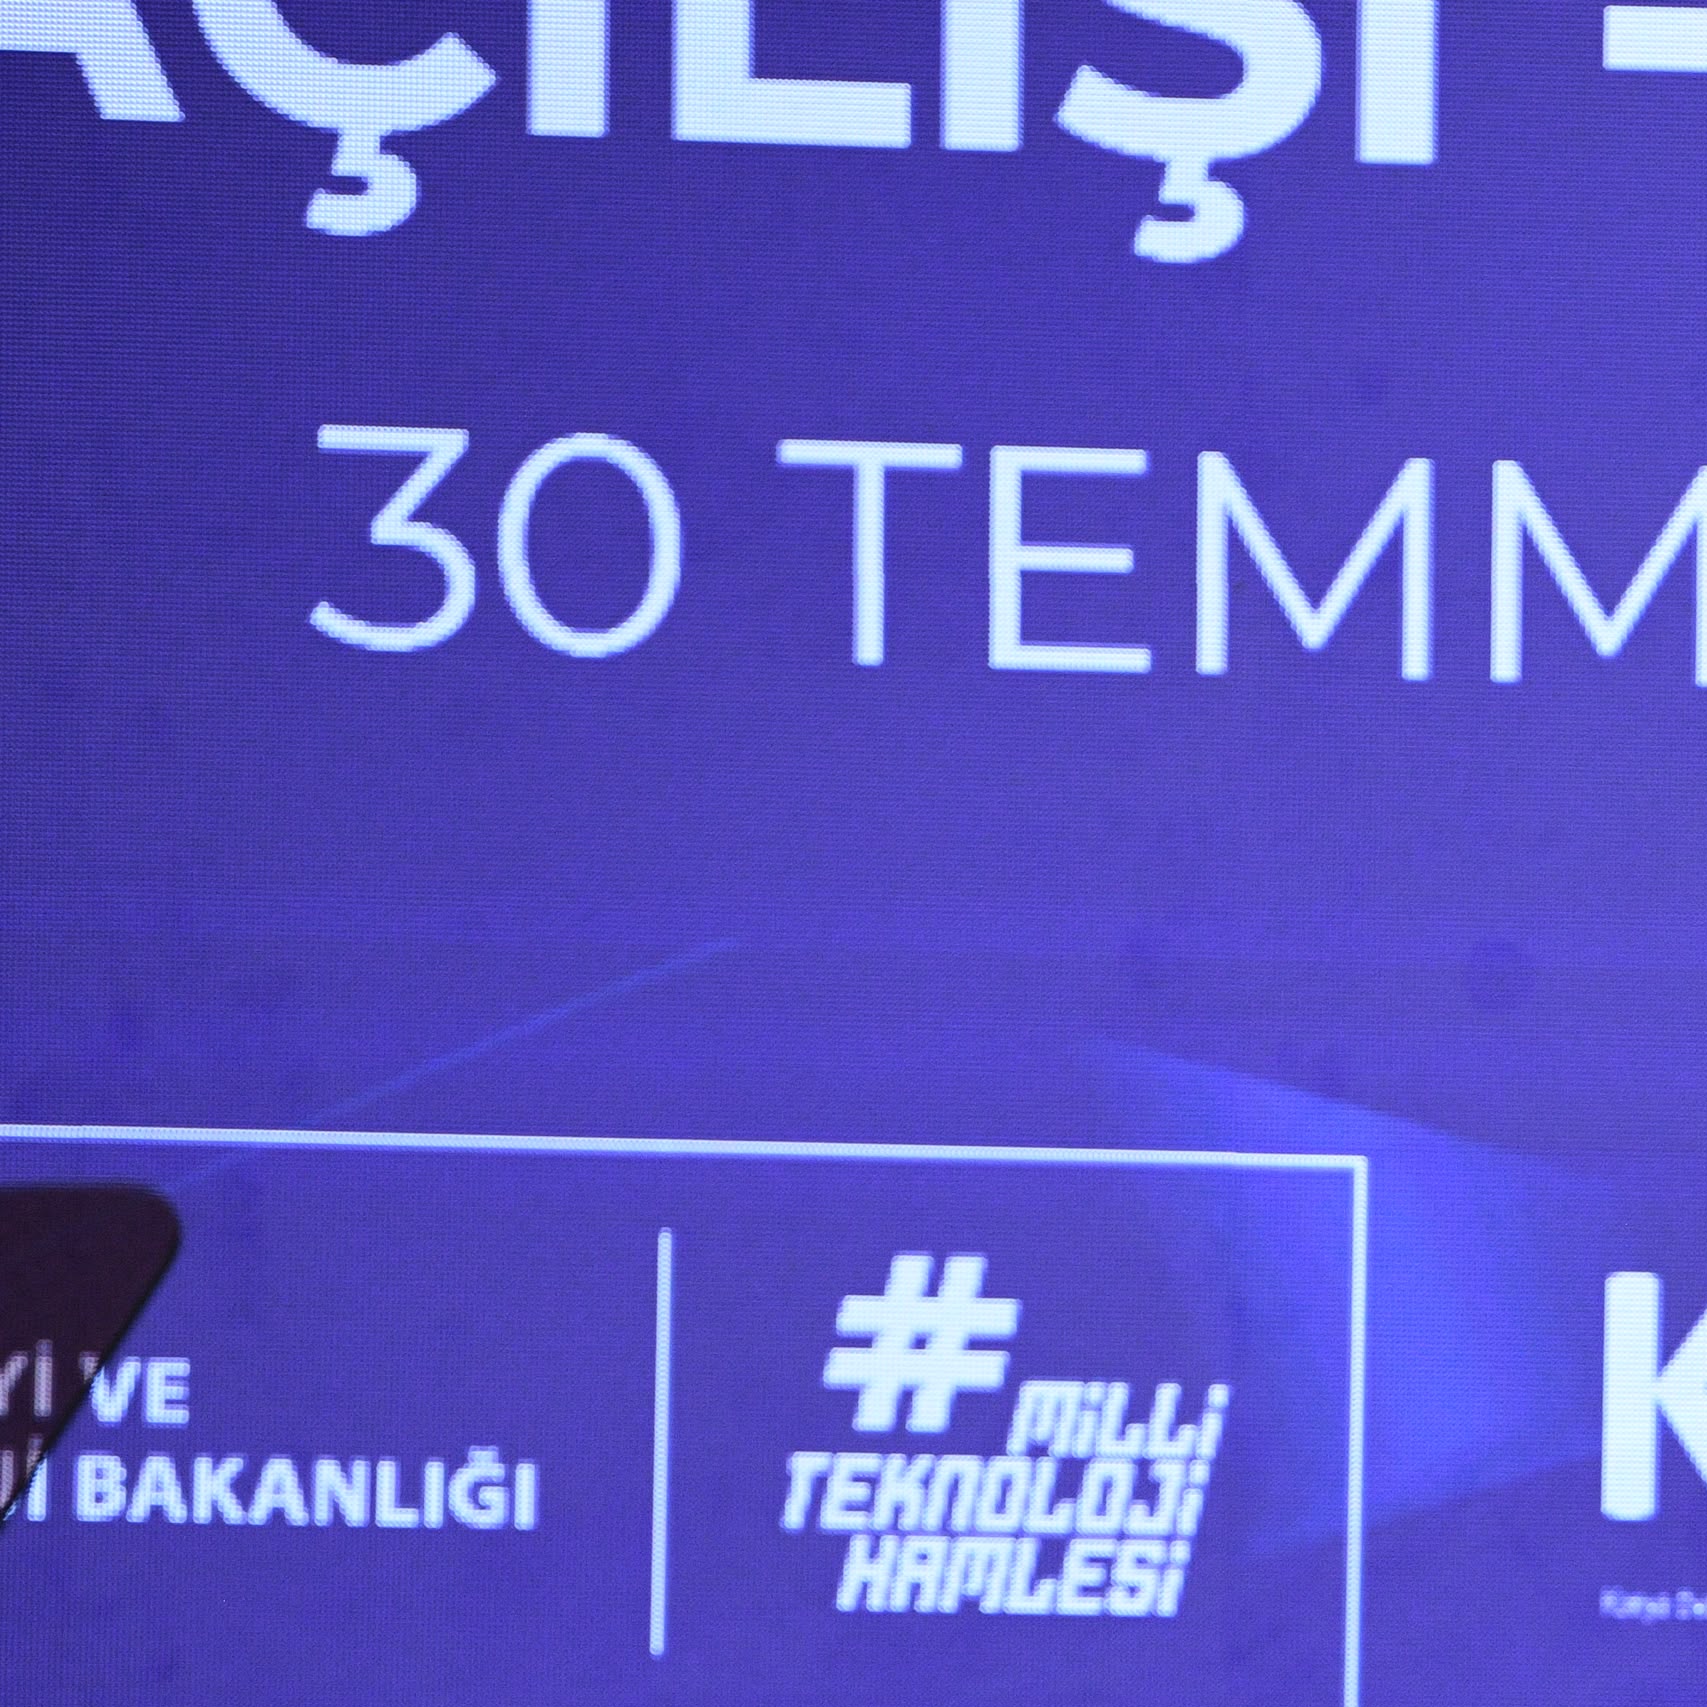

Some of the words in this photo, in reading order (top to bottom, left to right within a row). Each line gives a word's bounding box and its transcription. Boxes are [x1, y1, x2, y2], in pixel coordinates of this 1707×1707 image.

[311, 425, 680, 657] 30
[79, 1353, 190, 1426] VE
[76, 1448, 536, 1529] BAKANLIĞI
